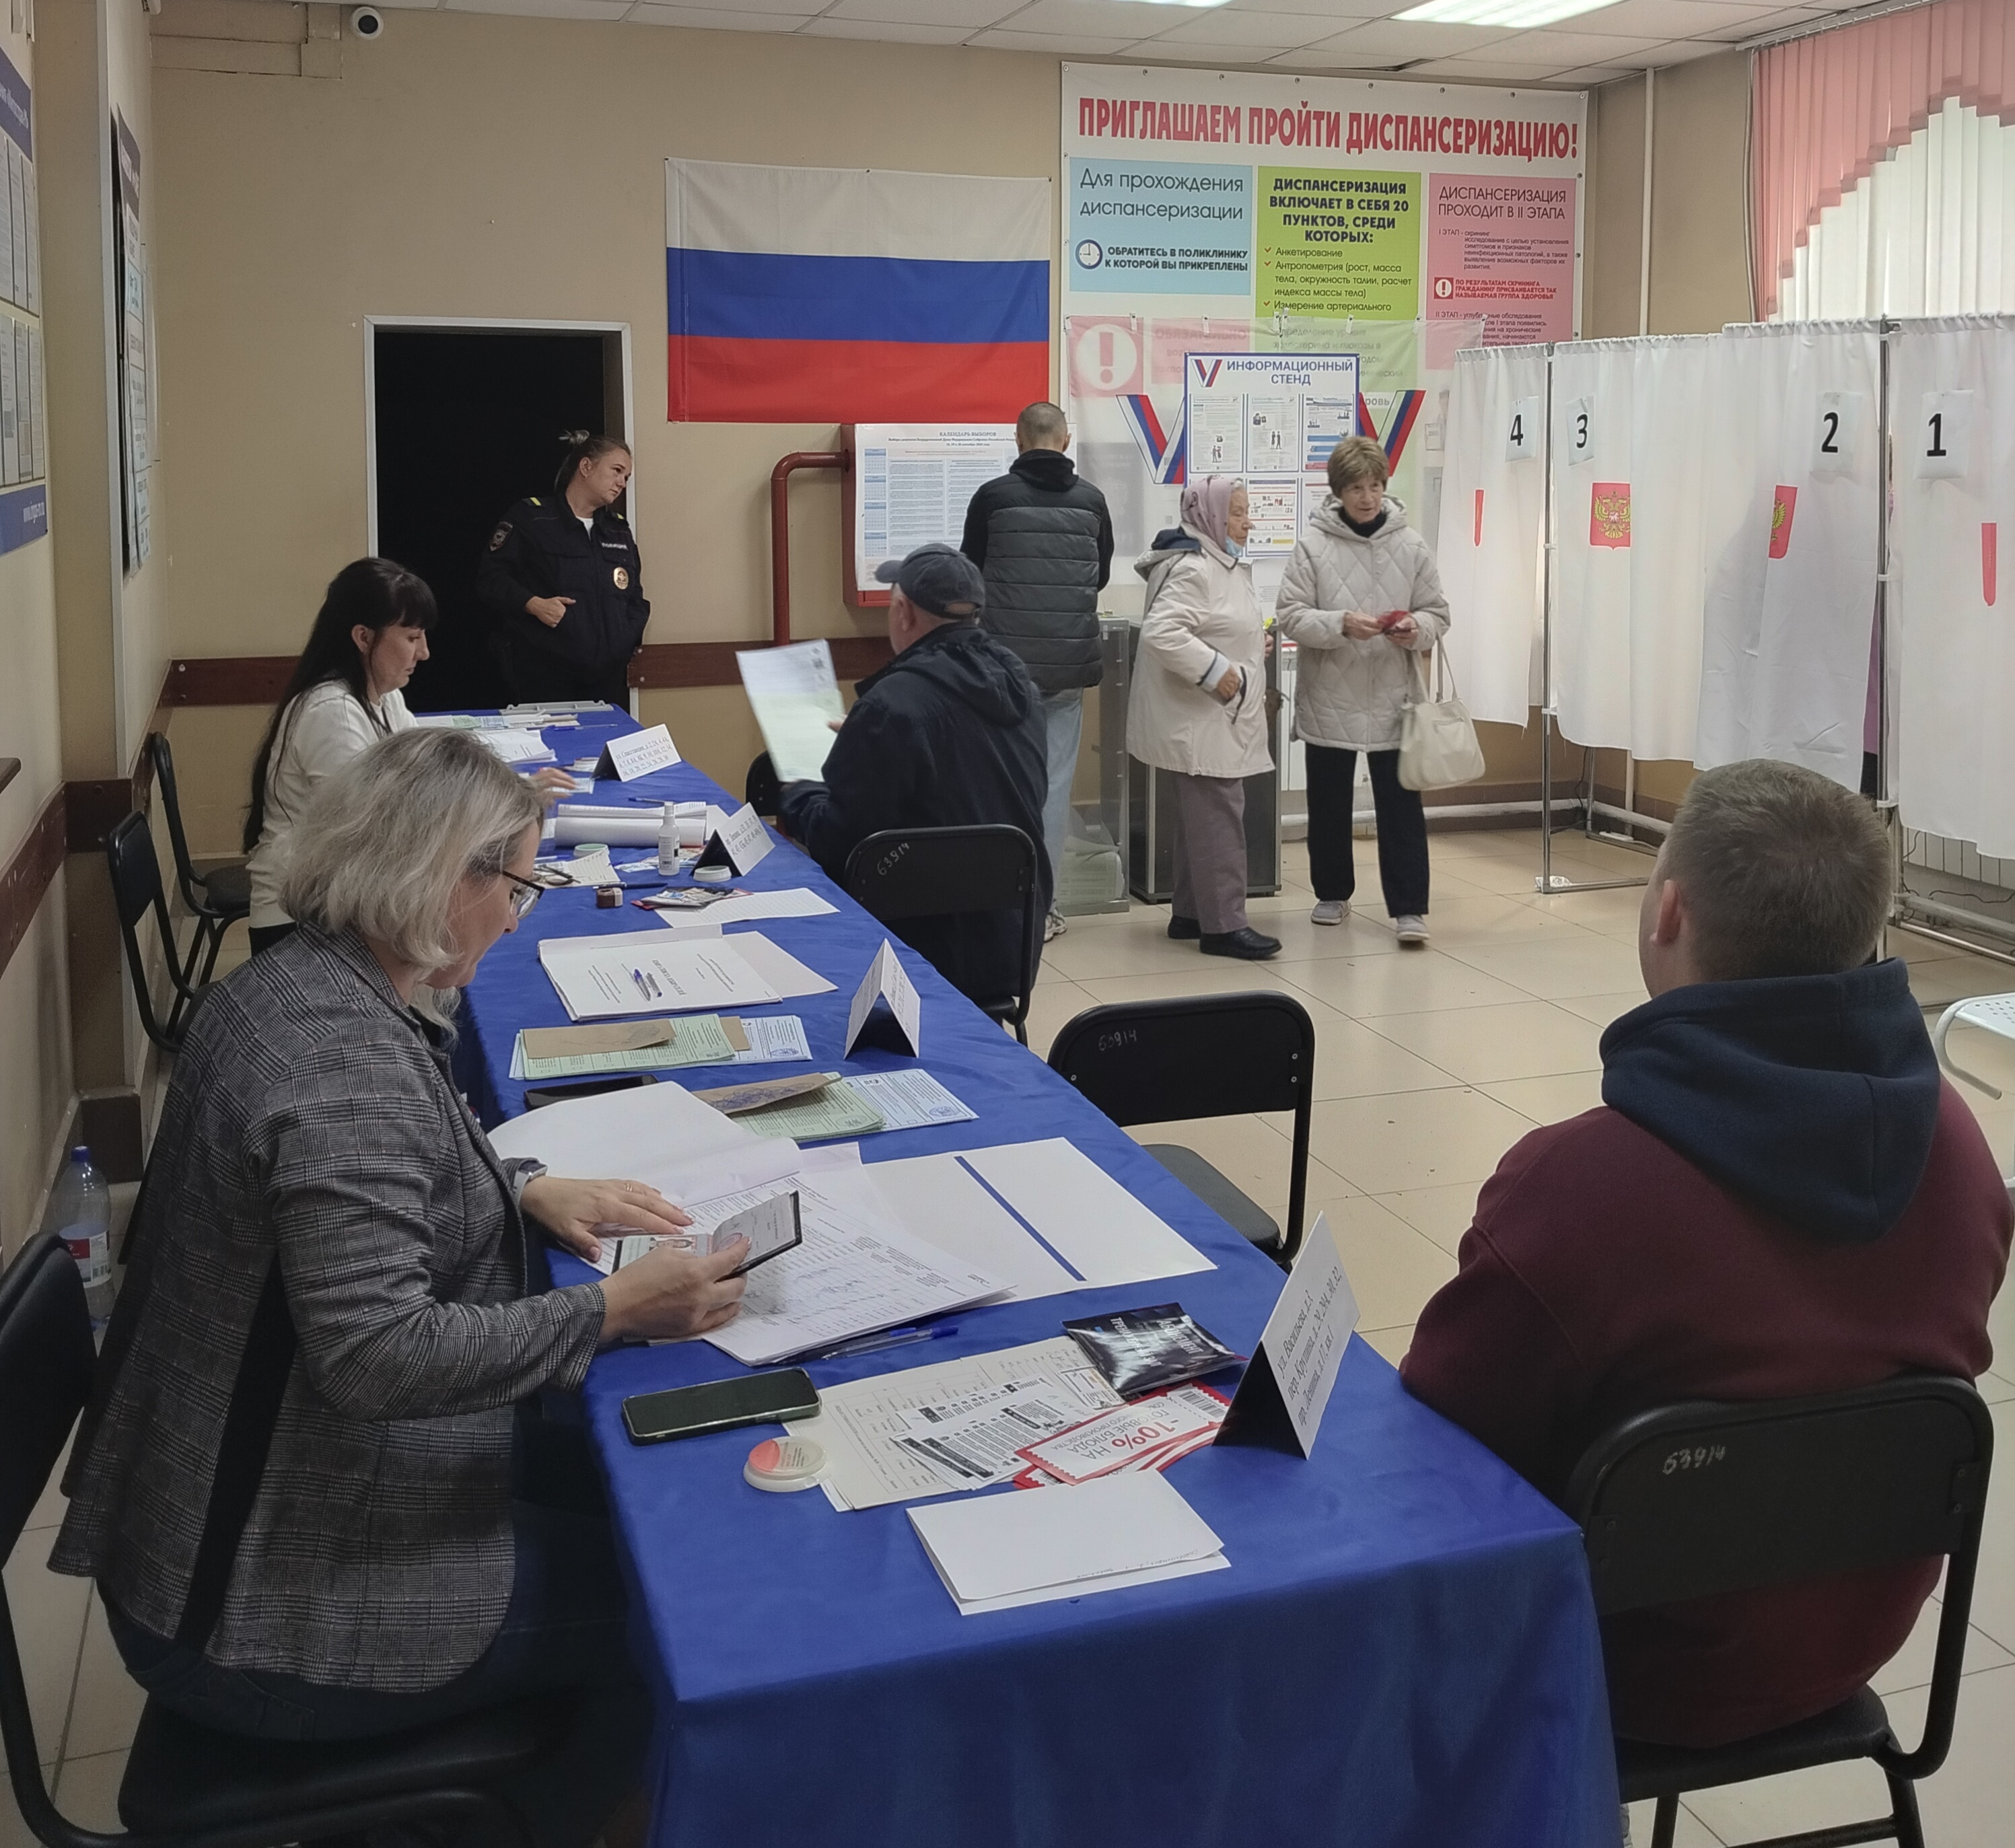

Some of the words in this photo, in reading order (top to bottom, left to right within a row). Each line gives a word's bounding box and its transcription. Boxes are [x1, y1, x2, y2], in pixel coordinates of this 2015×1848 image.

[1079, 98, 1241, 144] ПРИГЛАШАЕМ
[1248, 100, 1341, 148] ПРОЙТИ
[1346, 112, 1578, 163] ДИСПАНСЕРИЗАЦИЮ!
[1080, 168, 1113, 189] Для
[1119, 174, 1244, 192] прохождения
[1273, 178, 1407, 195] ДИСПАНСЕРИЗАЦИЯ
[1440, 186, 1566, 204] ДИСПАНСЕРИЗАЦИЯ
[1080, 202, 1243, 222] диспансеризации
[1269, 196, 1343, 209] ВКЛЮЧАЕТ
[1346, 199, 1354, 210] В
[1357, 199, 1390, 211] СЕБЯ
[1393, 200, 1409, 212] 20
[1438, 204, 1504, 219] ПРОХОДИТ
[1508, 206, 1514, 218] В
[1526, 207, 1565, 219] ЭТАПА
[1283, 214, 1349, 229] ПУНКТОВ,
[1353, 217, 1396, 230] СРЕДИ
[1305, 230, 1374, 243] КОТОРЫХ:
[1107, 246, 1168, 257] ОБРАТИТЕСЬ
[1171, 248, 1176, 256] В
[1178, 248, 1248, 259] ПОЛИКЛИНИКУ
[1275, 247, 1343, 258] Анкетирование
[1104, 259, 1111, 267] К
[1113, 258, 1159, 269] КОТОРОЙ
[1162, 261, 1176, 269] ВЫ
[1179, 262, 1248, 271] ПРИКРЕПЛЕНЫ
[1275, 261, 1343, 273] Антропометрия
[1346, 262, 1370, 273] (рост,
[1373, 264, 1401, 273] масса
[1275, 275, 1297, 284] тела,
[1300, 277, 1351, 285] окружность
[1353, 277, 1379, 285] талии,
[1382, 278, 1412, 287] расчет
[1345, 289, 1366, 299] тела)
[1274, 301, 1324, 311] Измерение
[1327, 303, 1392, 312] артериального
[1227, 359, 1353, 373] ИНФОРМАЦИОННЫЙ
[1271, 374, 1311, 386] СТЕНД
[1365, 397, 1390, 407] ровь
[1510, 415, 1524, 447] 4
[1576, 414, 1588, 448] 3
[1821, 413, 1839, 453] 2
[1927, 414, 1946, 457] 1
[1112, 1408, 1170, 1433] ГОТОВЫЕ
[1067, 1431, 1116, 1452] БЛЮДА
[1110, 1419, 1179, 1450] -10%
[1081, 1445, 1112, 1460] НА
